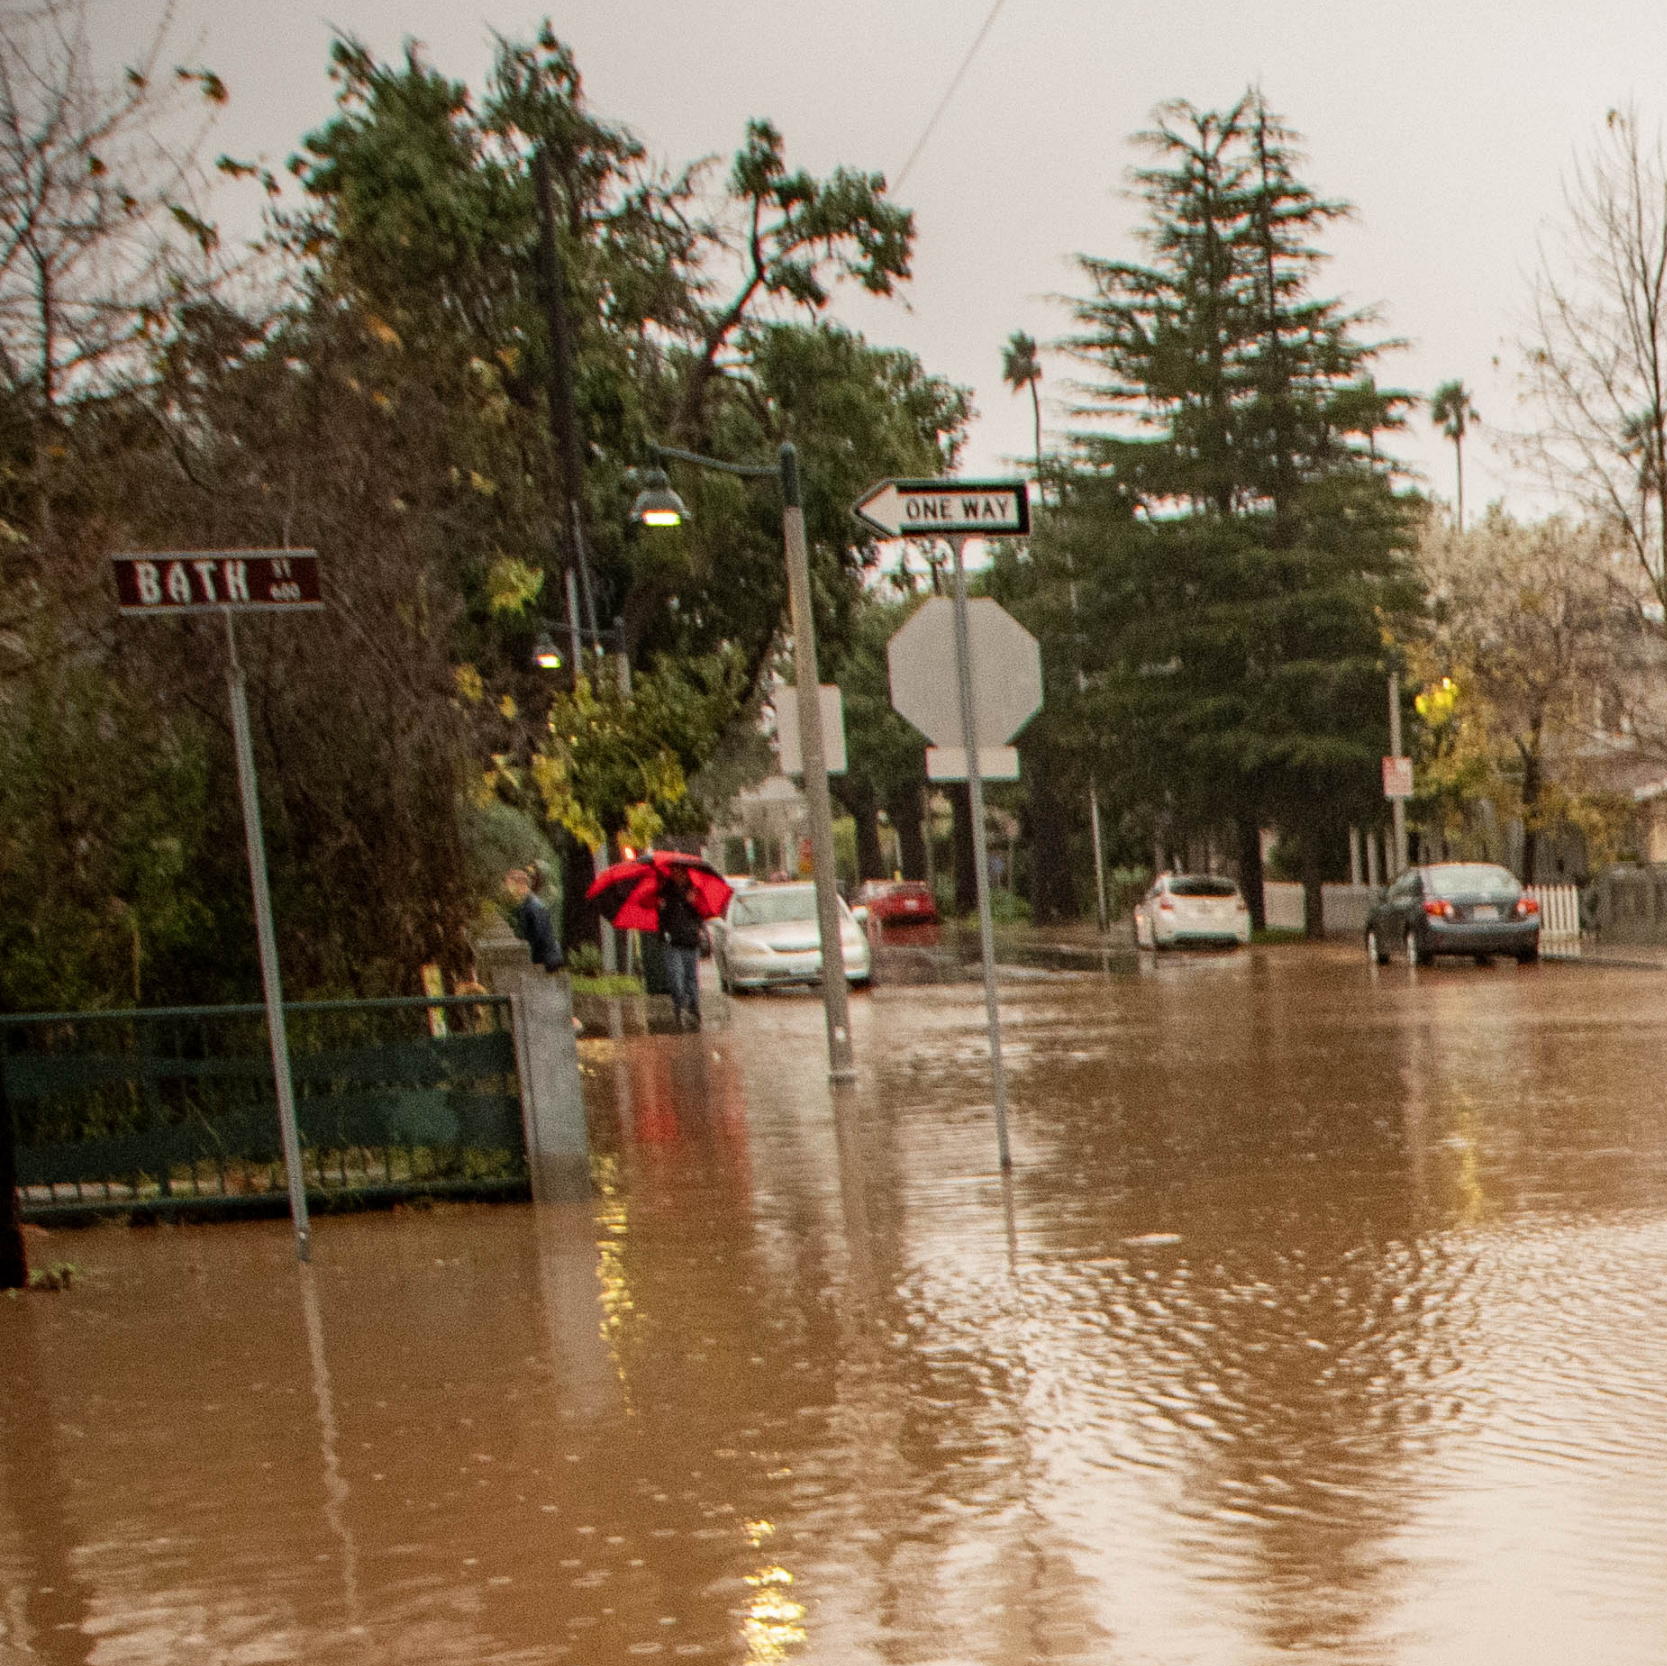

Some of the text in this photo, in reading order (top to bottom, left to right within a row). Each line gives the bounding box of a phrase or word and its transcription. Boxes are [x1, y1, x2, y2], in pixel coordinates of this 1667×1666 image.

[906, 496, 1008, 520] ONE WAY
[135, 559, 250, 603] BATH
